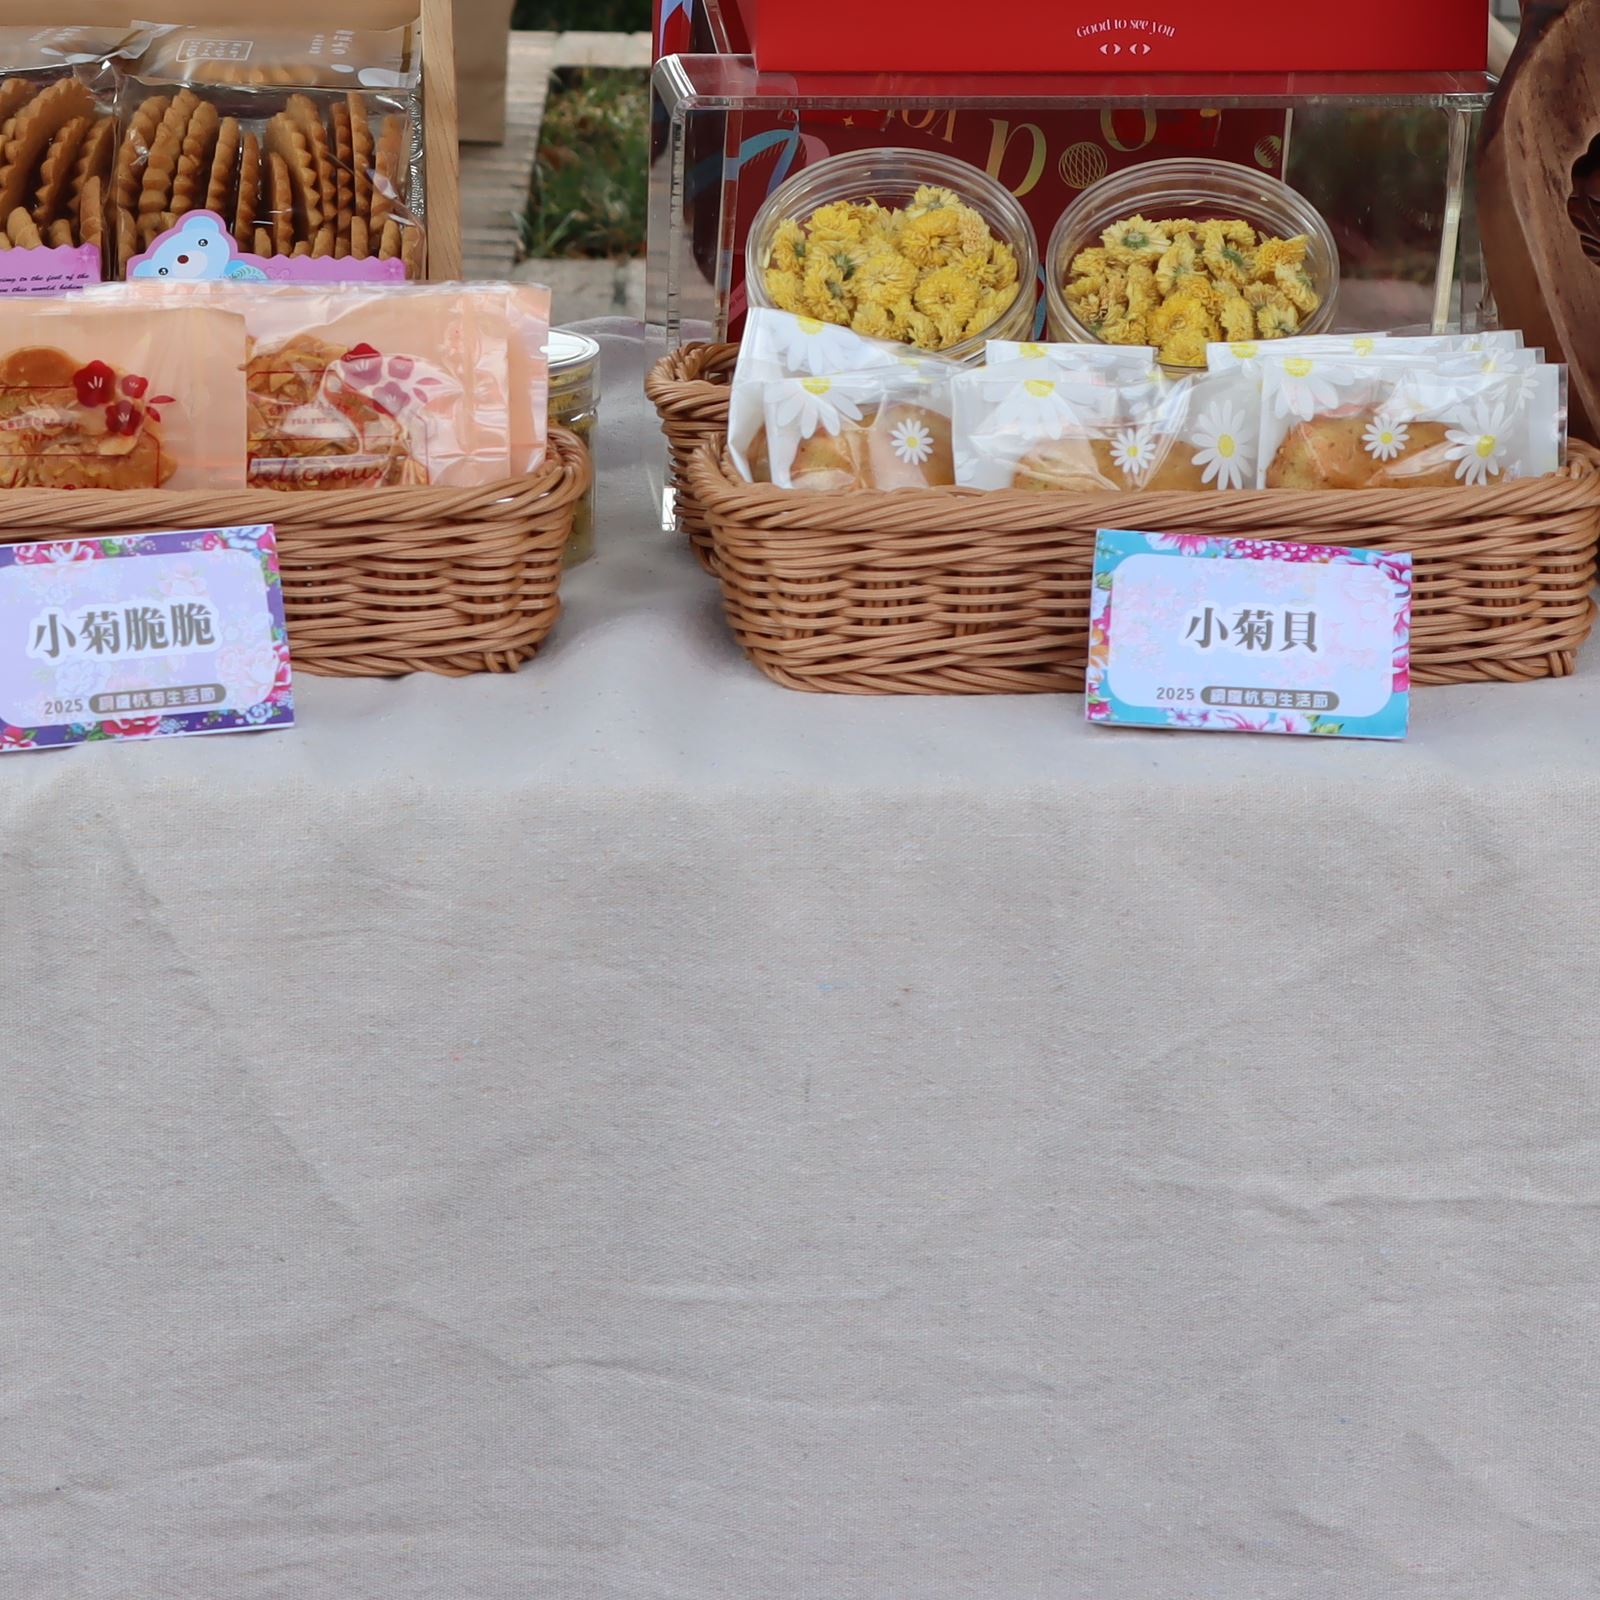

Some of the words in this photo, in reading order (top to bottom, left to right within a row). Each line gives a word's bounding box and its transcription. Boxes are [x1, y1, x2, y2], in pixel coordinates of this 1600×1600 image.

[1076, 18, 1111, 37] Good
[1114, 19, 1127, 30] to
[1130, 19, 1148, 30] see
[33, 602, 216, 659] 小菊脆脆
[1185, 606, 1319, 654] 小菊貝
[1156, 686, 1196, 701] 2025
[44, 698, 83, 715] 2025
